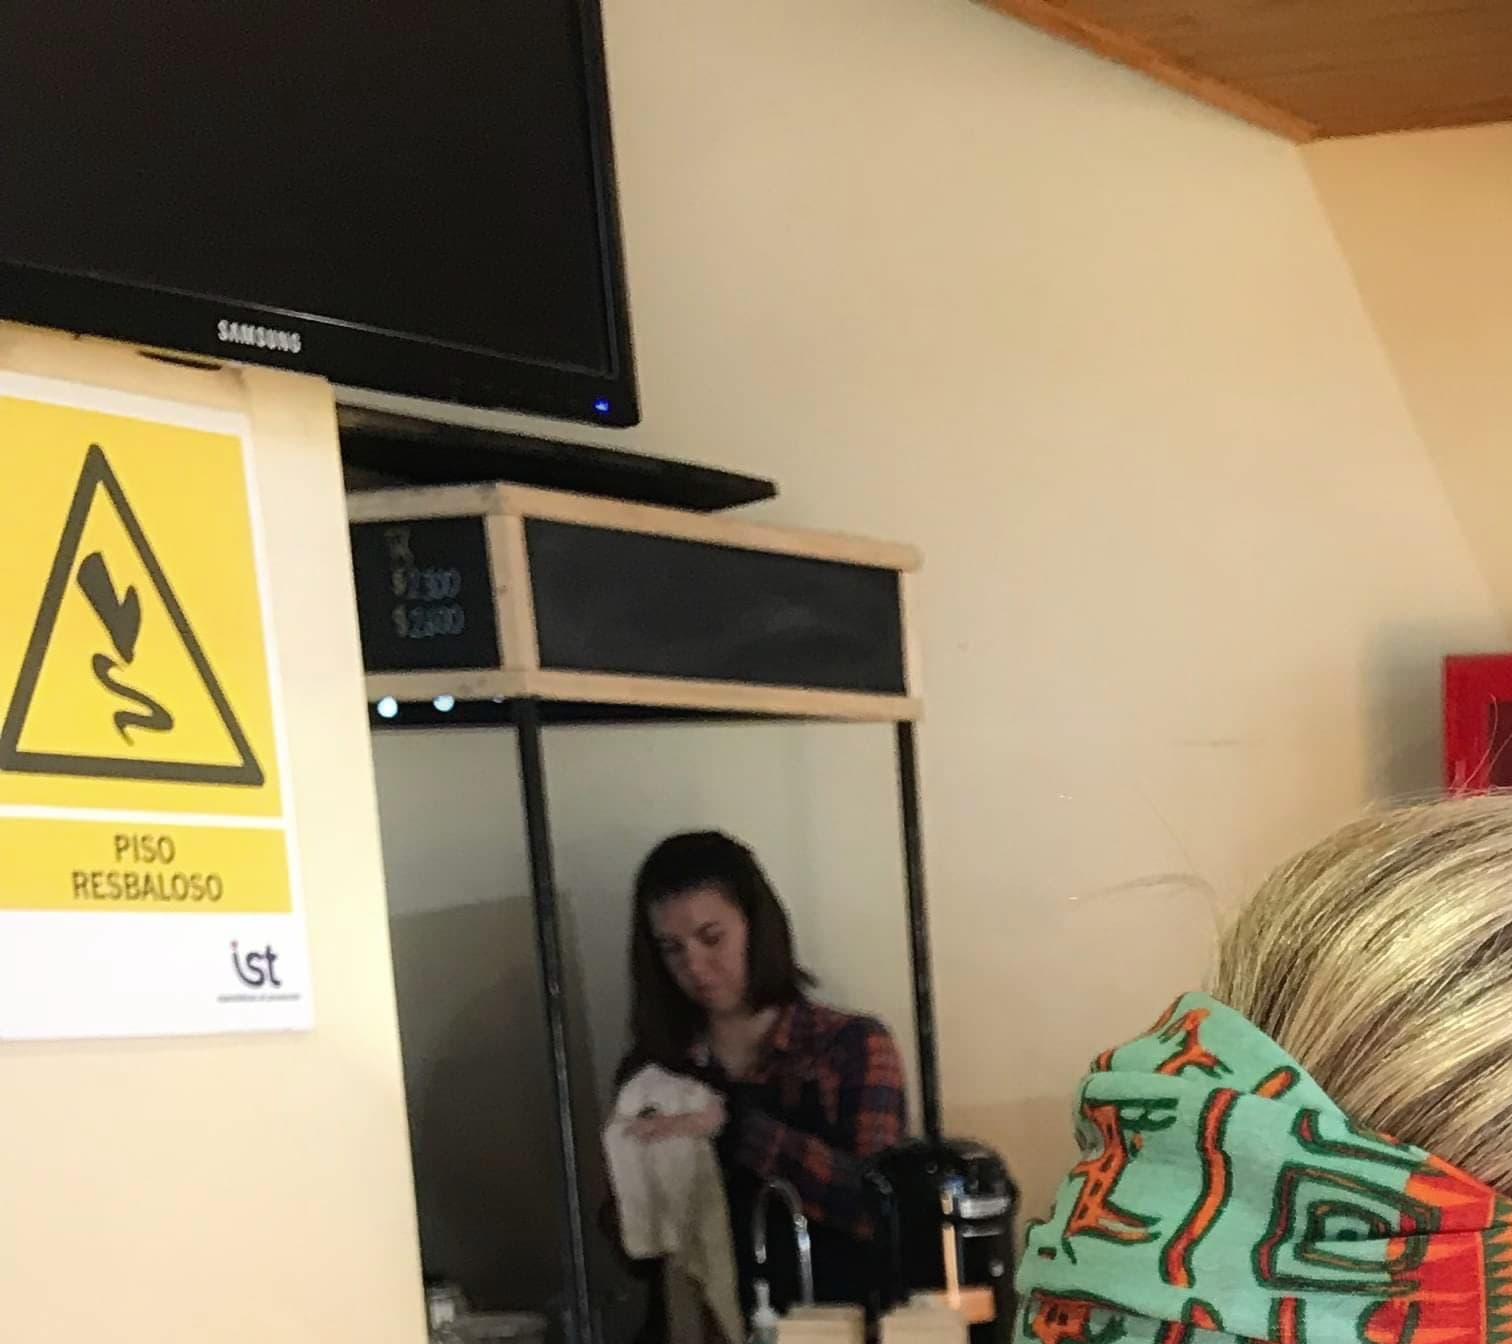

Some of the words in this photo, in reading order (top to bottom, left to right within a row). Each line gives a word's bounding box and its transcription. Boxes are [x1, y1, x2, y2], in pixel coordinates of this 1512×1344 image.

[217, 319, 302, 354] SAMSUNG
[114, 833, 176, 865] PISO
[71, 869, 224, 902] RESBALOSO
[230, 939, 282, 988] ist
